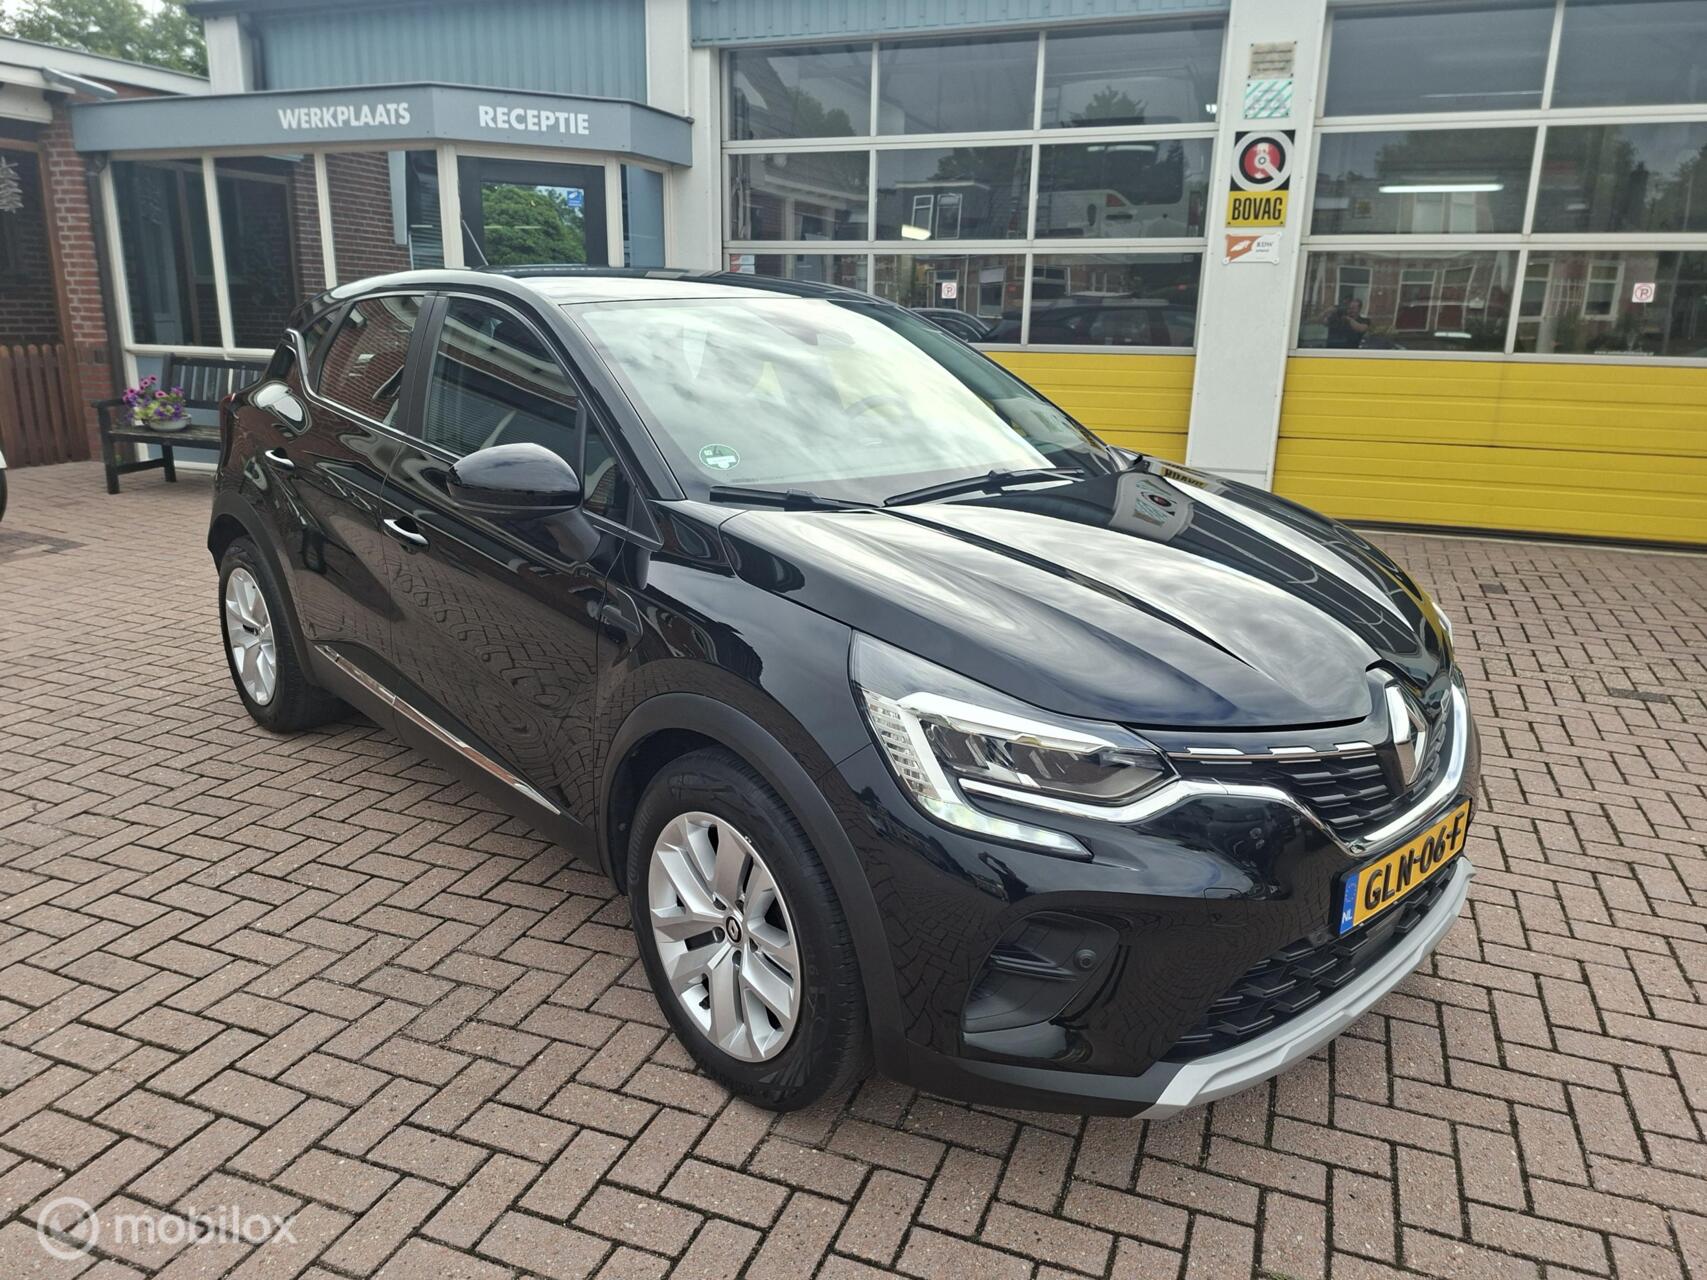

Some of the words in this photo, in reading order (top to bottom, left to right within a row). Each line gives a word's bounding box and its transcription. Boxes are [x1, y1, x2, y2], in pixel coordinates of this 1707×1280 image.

[277, 102, 411, 130] WERKPLAATS
[478, 105, 590, 135] RECEPTIE
[1231, 196, 1283, 221] BOVAG
[1364, 811, 1466, 911] GLN-06-F
[1341, 911, 1353, 924] NL
